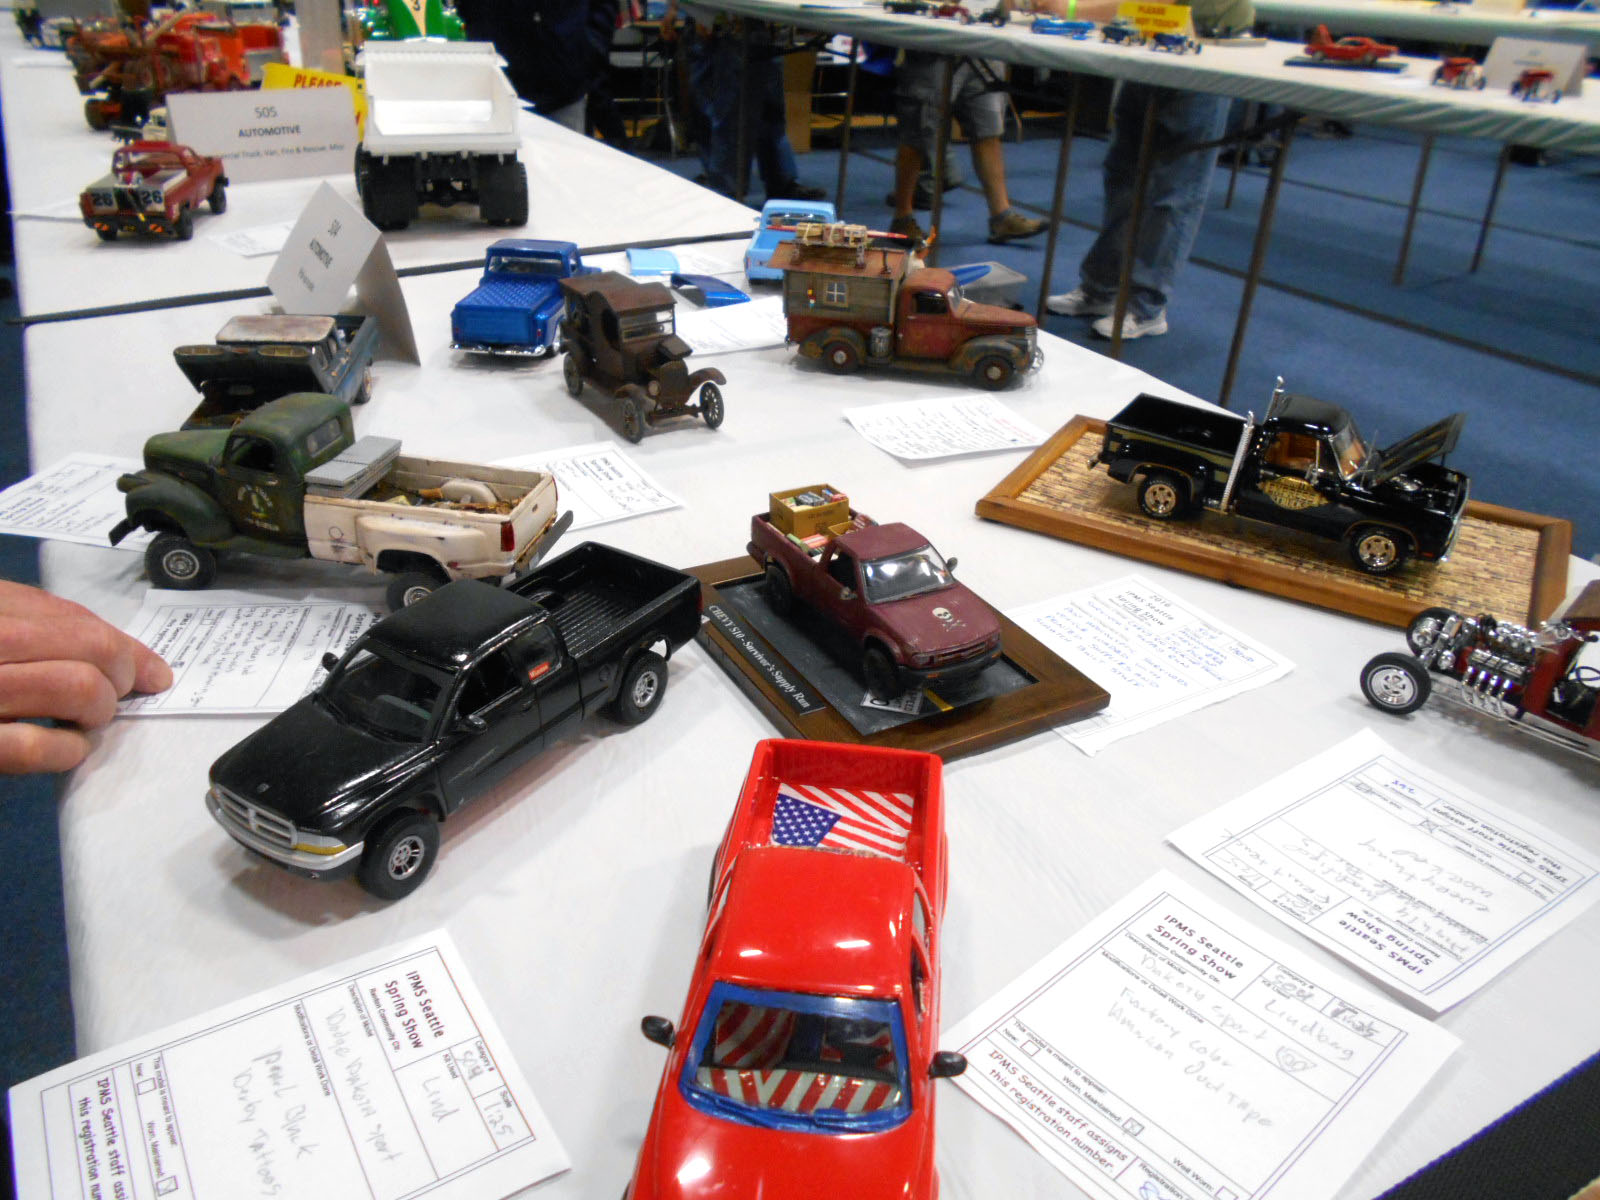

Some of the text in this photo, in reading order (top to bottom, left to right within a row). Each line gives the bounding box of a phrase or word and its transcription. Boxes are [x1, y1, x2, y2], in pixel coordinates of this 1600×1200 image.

[254, 106, 278, 119] 505
[238, 125, 301, 138] AUTOMOTIVE
[142, 190, 163, 205] 26
[348, 613, 367, 633] Spring
[1113, 594, 1145, 612] Spring
[1141, 611, 1167, 626] Show
[1143, 602, 1176, 620] Seattle
[708, 604, 735, 627] CHEVY
[743, 640, 777, 673] Survivor's
[771, 670, 797, 693] Supply
[793, 692, 811, 708] Run
[1151, 924, 1238, 980] Spring Show
[1161, 914, 1246, 968] IPMS Seattle
[1335, 919, 1424, 974] IPMS Seattle
[1343, 910, 1434, 965] Spring Show
[1168, 949, 1208, 976] Community
[381, 979, 426, 1050] Spring Show
[404, 969, 448, 1038] IPMS Seattle
[375, 1007, 397, 1041] Community
[1011, 1019, 1029, 1034] This
[1025, 1030, 1048, 1049] model
[1051, 1051, 1075, 1071] meant
[96, 1076, 112, 1106] IPMS
[155, 1068, 166, 1089] model
[78, 1095, 92, 1117] this
[160, 1094, 171, 1115] meant
[986, 1066, 1013, 1090] this
[1005, 1082, 1074, 1143] registration
[987, 1048, 1129, 1166] IPMS Seattle staff assigns
[101, 1105, 120, 1147] Seattle
[78, 1116, 102, 1183] registration
[107, 1146, 125, 1178] staff
